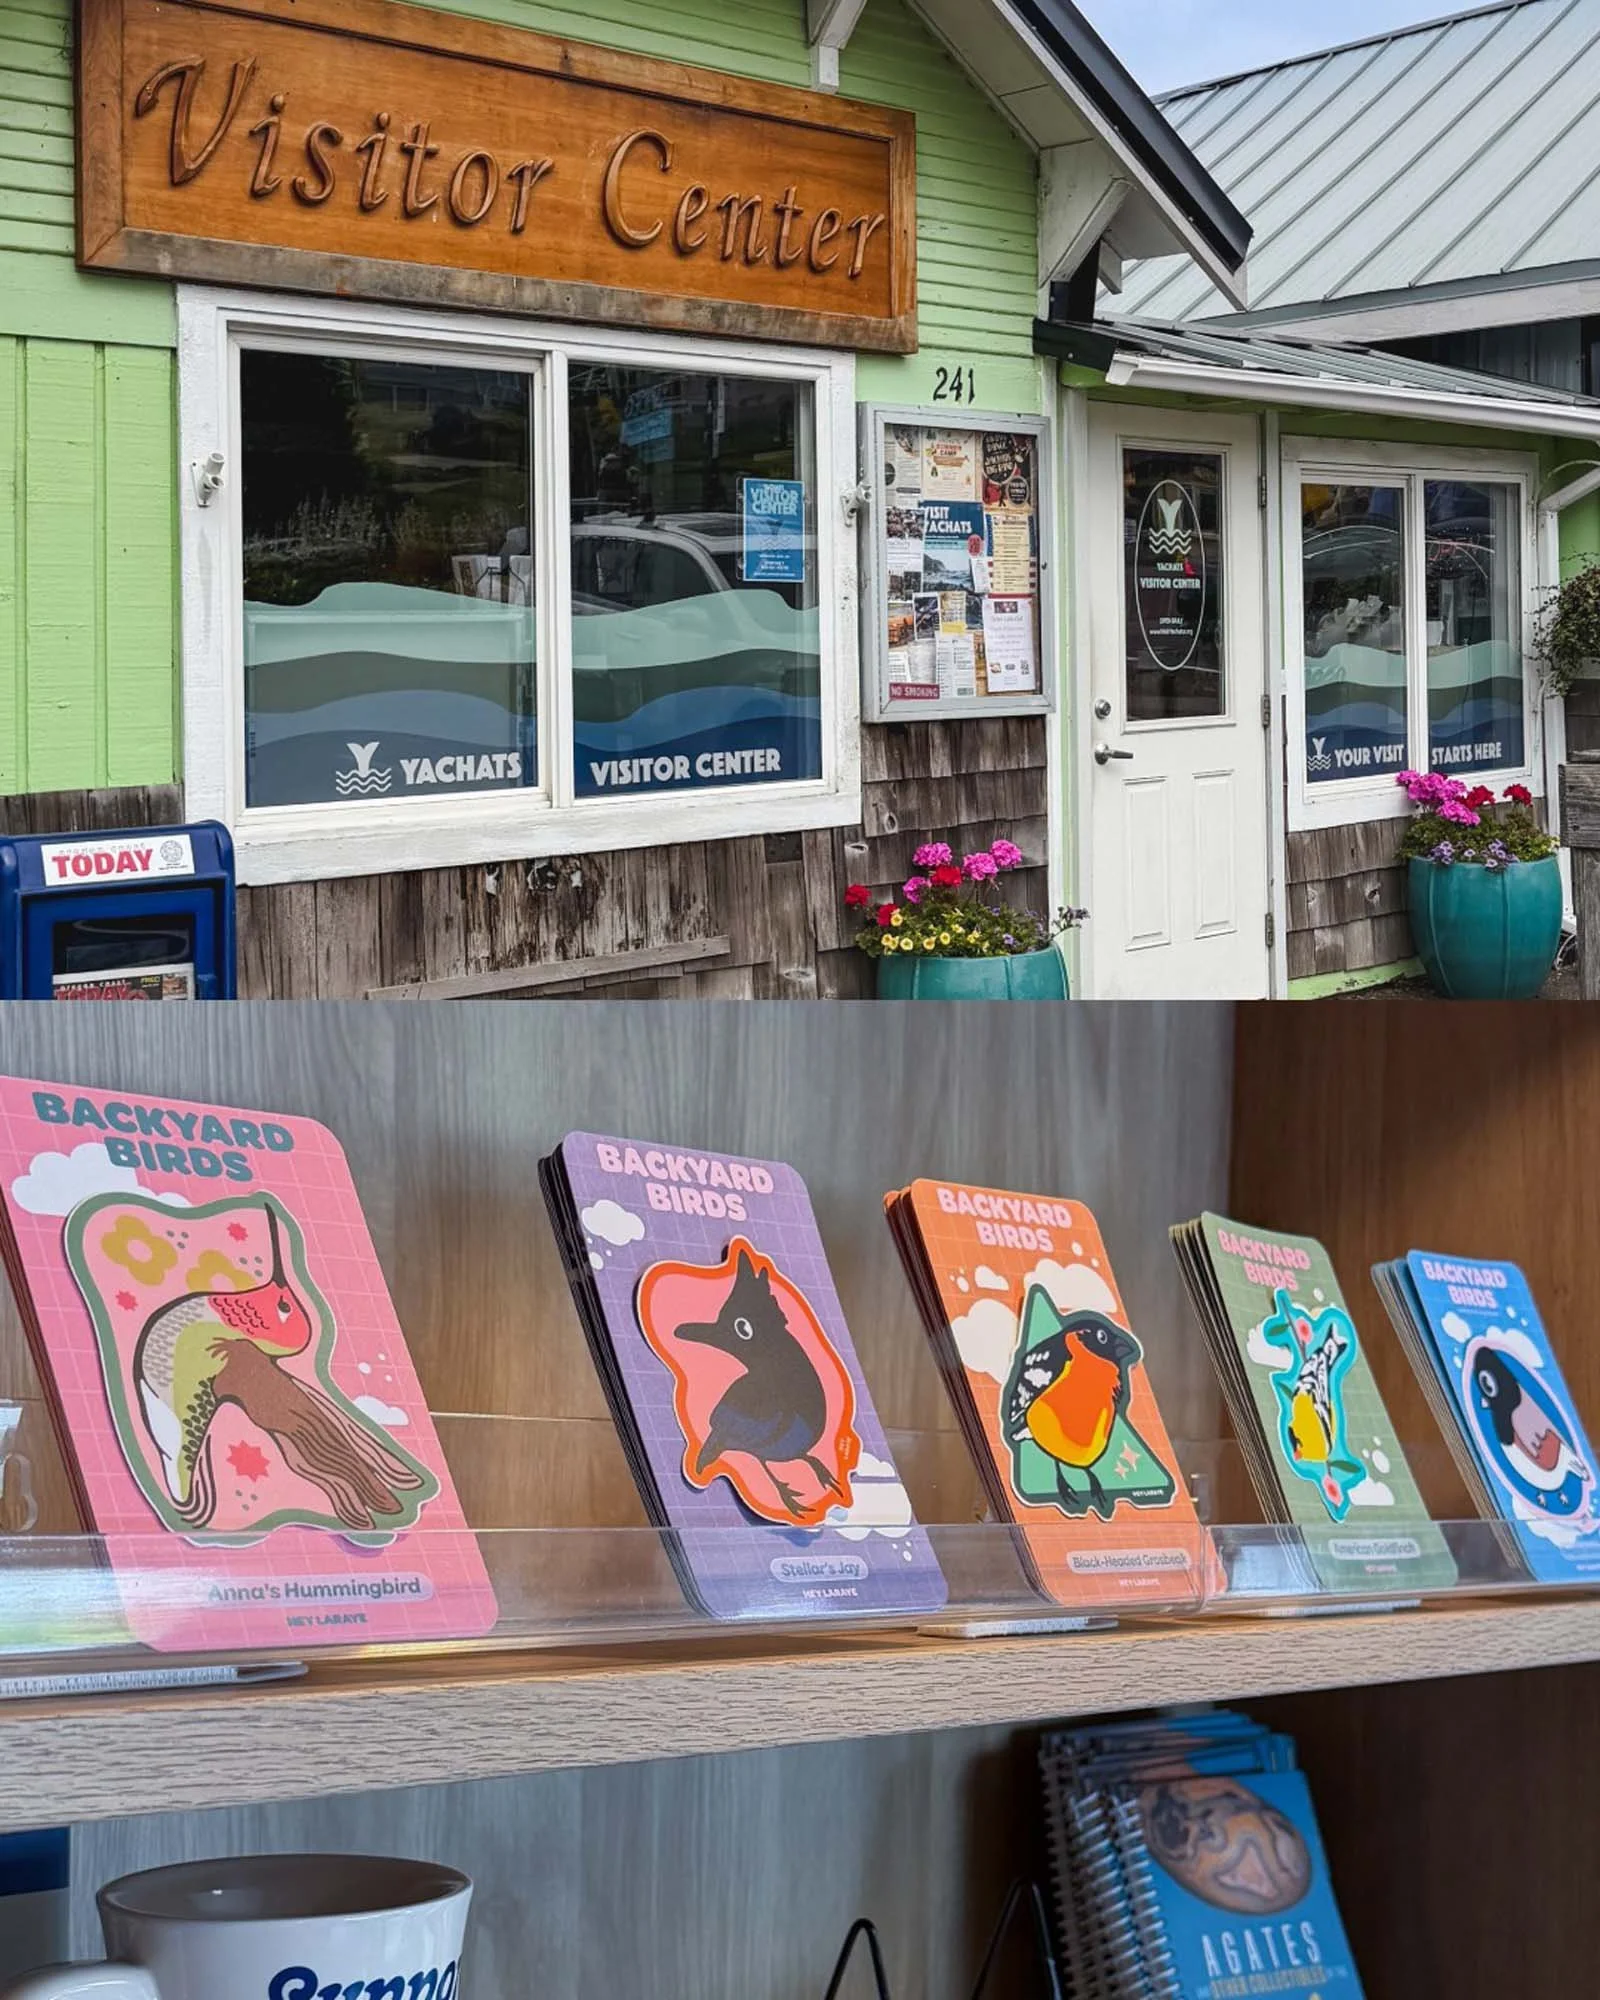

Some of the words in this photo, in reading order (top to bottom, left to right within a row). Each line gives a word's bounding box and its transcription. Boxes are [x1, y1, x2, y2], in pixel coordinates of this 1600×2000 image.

[134, 55, 556, 236] Visitor
[604, 127, 886, 280] Center
[932, 366, 976, 404] 241
[750, 487, 799, 503] VISITOR
[752, 501, 798, 516] CENTER
[1140, 577, 1172, 589] VISITOR
[1172, 577, 1201, 589] CENTER
[891, 685, 903, 697] NO
[904, 686, 939, 697] SMOKING
[399, 752, 523, 785] YACHATS
[589, 754, 692, 787] VISITOR
[695, 747, 782, 778] CENTER
[1334, 746, 1371, 768] YOUR
[1372, 744, 1405, 763] VISIT
[1431, 744, 1473, 765] STARTS
[1475, 742, 1502, 761] HERE
[51, 848, 153, 879] TODAY
[31, 1091, 295, 1153] BACKYARD
[103, 1135, 254, 1183] BIRDS
[596, 1143, 775, 1195] BACKYARD
[645, 1182, 748, 1222] BIRDS
[936, 1187, 1073, 1229] BACKYARD
[975, 1220, 1055, 1253] BIRDS
[1217, 1227, 1312, 1271] BACKYARD
[1243, 1260, 1300, 1292] BIRDS
[1421, 1259, 1508, 1289] BACKYARD
[1447, 1284, 1498, 1309] BIRDS
[837, 1561, 861, 1577] Jay
[208, 1583, 281, 1601] Anna's
[284, 1577, 421, 1600] Hummingbird
[802, 1589, 823, 1599] HEY
[287, 1615, 314, 1626] HEY
[315, 1612, 368, 1625] LARAYE
[1201, 1920, 1322, 1978] AGATES
